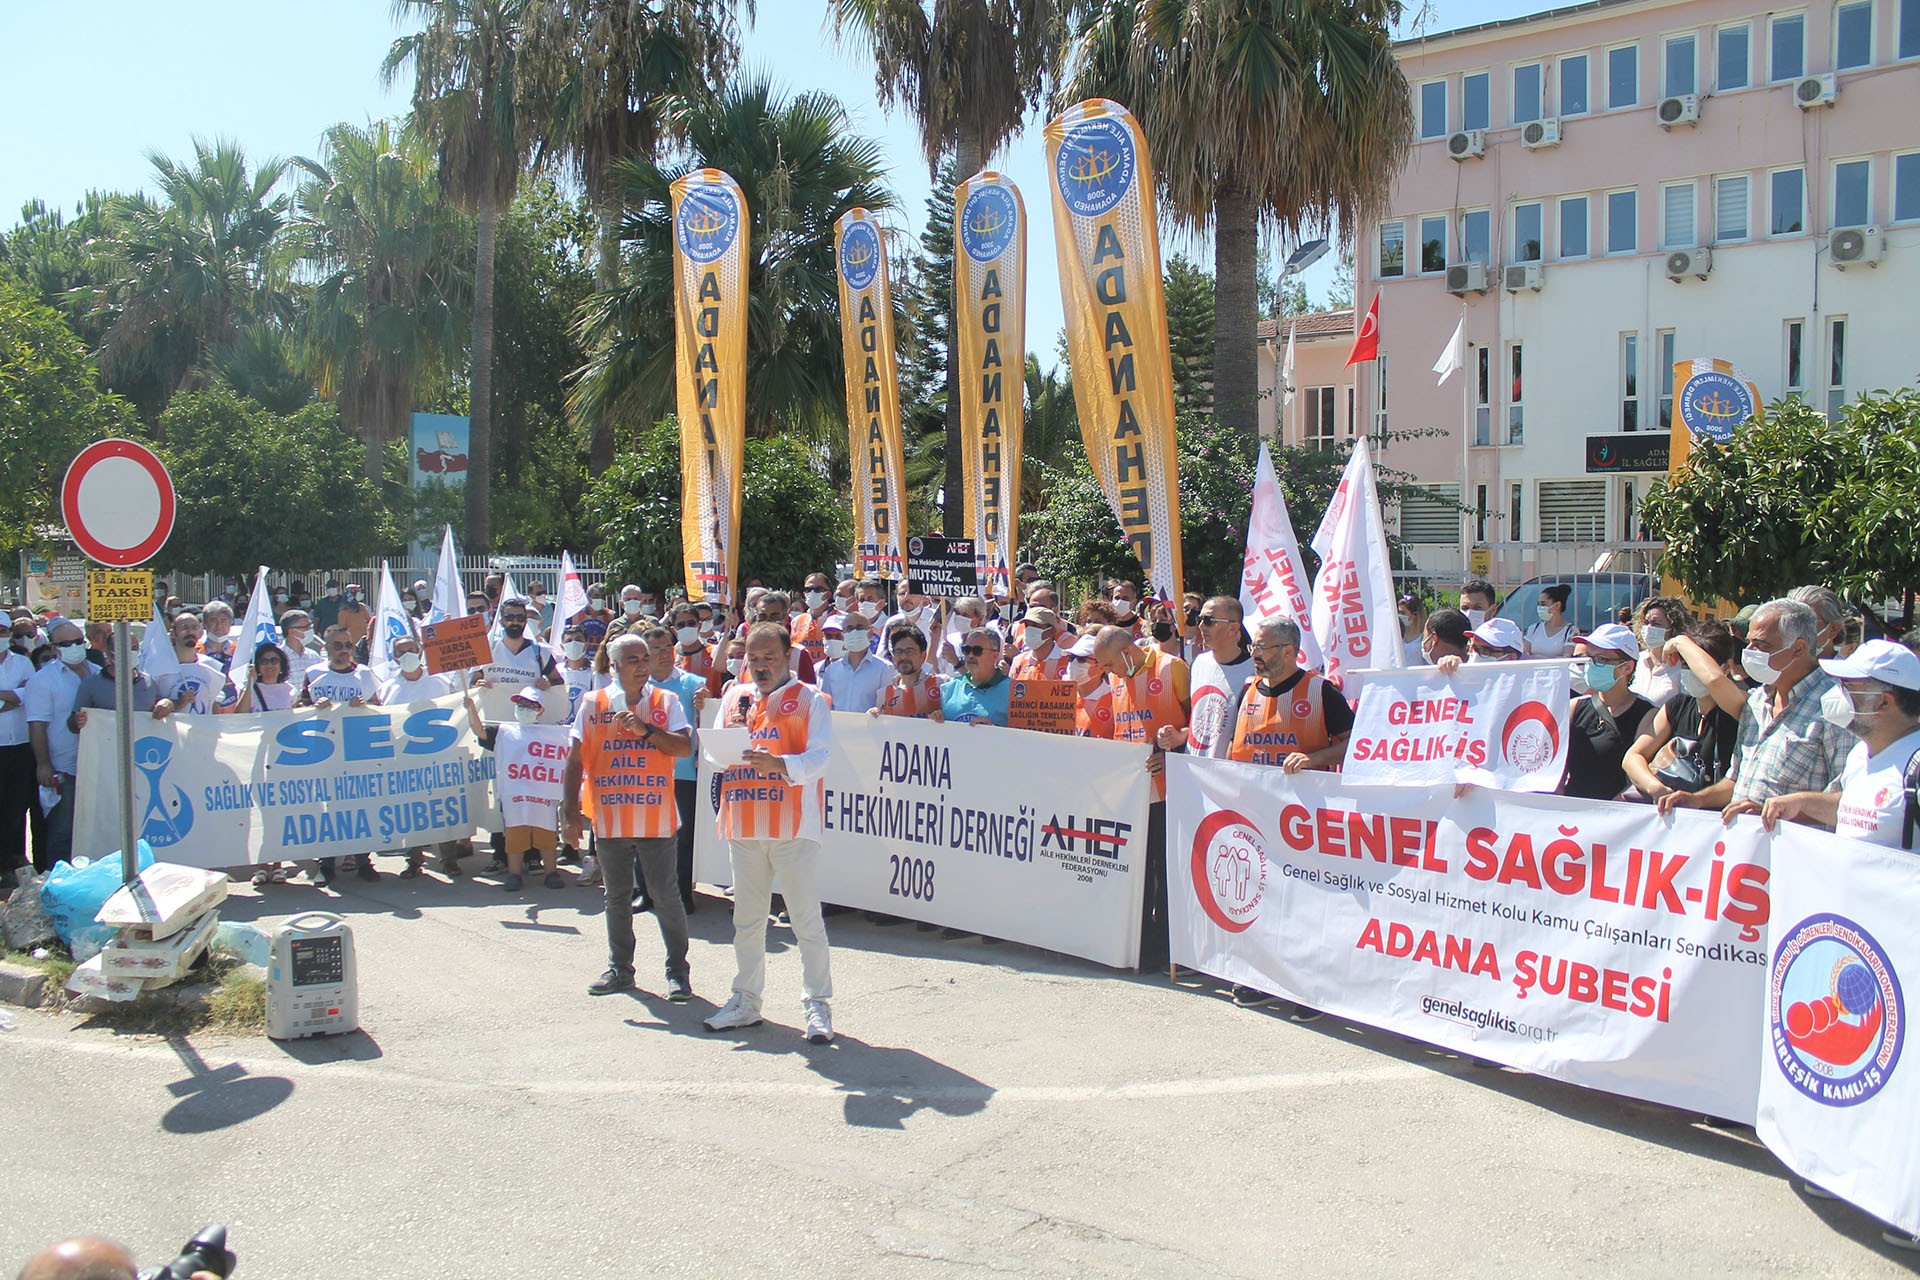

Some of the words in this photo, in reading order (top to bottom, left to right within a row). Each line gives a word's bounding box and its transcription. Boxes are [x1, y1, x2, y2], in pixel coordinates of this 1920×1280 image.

[1622, 458, 1631, 467] İL
[1633, 457, 1669, 468] SAĞLIK
[946, 541, 971, 554] AHEF
[919, 558, 944, 568] Hekimliği
[944, 559, 976, 569] Çalışanları
[109, 576, 146, 585] ADLİYE
[908, 568, 953, 583] MUTSUZ
[94, 585, 149, 598] TAKSİ
[922, 583, 978, 597] UMUTSUZ
[94, 604, 112, 612] 0535
[114, 604, 128, 612] 575
[128, 604, 138, 612] 02
[140, 604, 149, 612] 78
[439, 641, 473, 655] VARSA
[439, 657, 478, 671] YOKTUR
[487, 666, 536, 678] PERFORMANS
[314, 685, 337, 702] ESNEK
[1050, 684, 1074, 697] AHEF
[1010, 699, 1038, 710] BİRİNCİ
[1039, 700, 1075, 711] BASAMAK
[1388, 698, 1474, 726] GENEL
[1010, 710, 1039, 720] SAĞLIĞIN
[1040, 710, 1076, 721] TEMELİDİR,
[1115, 708, 1153, 724] ADANA
[1037, 720, 1057, 728] Temeli
[275, 708, 459, 766] SES
[1122, 727, 1145, 740] AİLE
[1243, 732, 1298, 746] ADANA
[602, 738, 658, 751] ADANA
[1353, 731, 1487, 770] SAĞLIK-İŞ
[610, 756, 647, 768] AİLE
[1252, 748, 1287, 766] AİLE
[879, 741, 952, 790] ADANA
[205, 780, 254, 812] SAĞLIK
[257, 782, 276, 808] VE
[279, 778, 331, 806] SOSYAL
[335, 770, 383, 800] HİZMET
[388, 756, 465, 796] EMEKÇİLERİ
[601, 791, 663, 806] DERNEĞİ
[724, 786, 784, 803] DERNEĞİ
[281, 808, 372, 847] ADANA
[378, 787, 468, 844] ŞUBESİ
[840, 786, 945, 846] HEKİMLERİ
[950, 804, 1036, 863] DERNEĞİ
[145, 834, 172, 843] 1996
[1040, 813, 1132, 861] AHEF
[1040, 848, 1054, 859] AİLE
[1055, 852, 1091, 864] HEKİMLERİ
[1092, 858, 1129, 873] DERNEKLERİ
[1232, 830, 1256, 847] GENEL
[1256, 845, 1267, 880] SAĞLIK
[889, 854, 935, 902] 2008
[1061, 862, 1108, 878] FEDERASYONU
[1279, 803, 1448, 874] GENEL
[1463, 823, 1771, 943] SAĞLIK-İŞ
[1077, 874, 1094, 883] 2008
[1282, 863, 1321, 883] Genel
[1324, 871, 1365, 891] Sağlık
[1368, 881, 1384, 894] ve
[1387, 883, 1431, 904] Sosyal
[1435, 891, 1487, 915] Hizmet
[1491, 901, 1527, 923] Kolu
[1532, 909, 1579, 934] Kamu
[1584, 919, 1671, 951] Çalışanları
[1355, 917, 1502, 981] ADANA
[1512, 949, 1672, 1024] ŞUBESİ
[1777, 950, 1792, 976] KAMU
[1789, 940, 1798, 953] İŞ
[1797, 920, 1834, 946] GÖRENLERİ
[1833, 924, 1880, 970] SENDİKALARI
[1877, 966, 1898, 1068] KONFEDERASYONU
[1422, 994, 1559, 1044] genelsaglikis.org.tr
[1773, 1027, 1819, 1094] BİRLEŞİK
[1823, 1066, 1881, 1100] KAMU-İŞ
[1813, 1059, 1834, 1077] 2008
